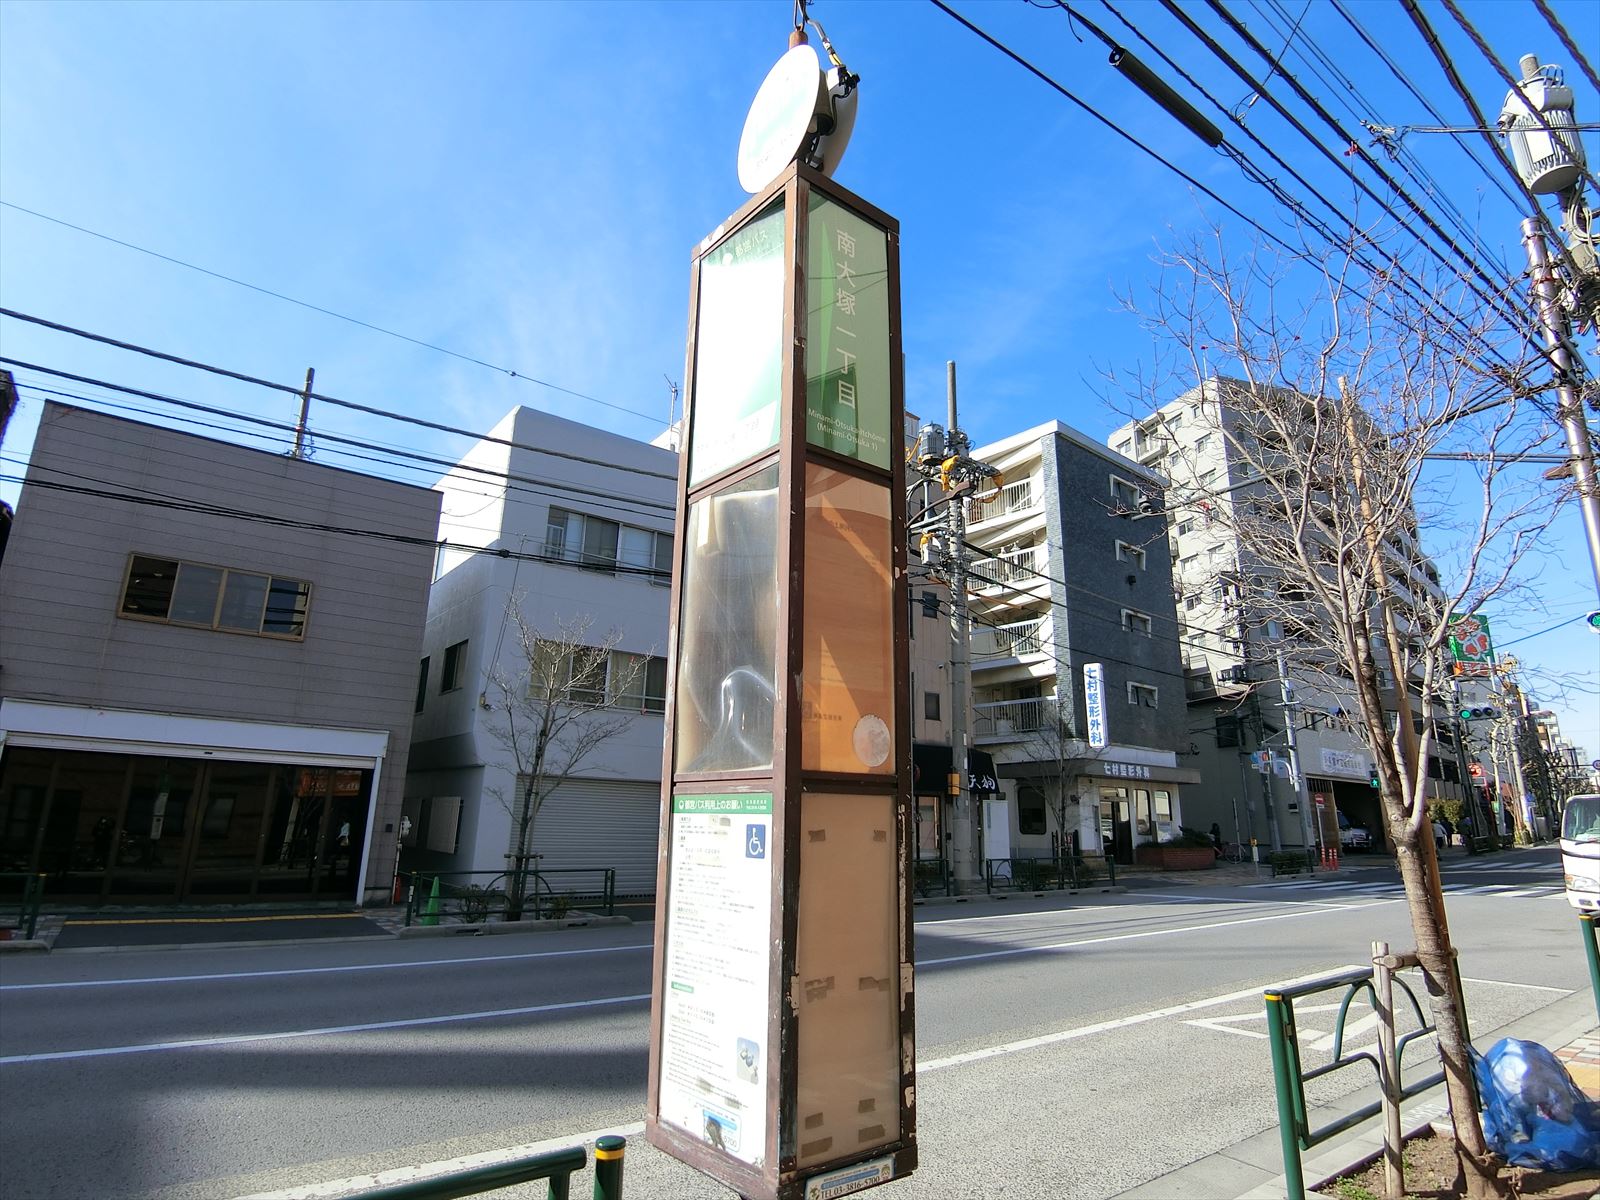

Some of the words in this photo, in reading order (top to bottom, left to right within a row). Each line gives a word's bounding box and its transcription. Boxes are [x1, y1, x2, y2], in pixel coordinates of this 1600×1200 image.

[735, 230, 768, 257] 都営バス
[836, 229, 857, 409] 南大塚一丁目
[1086, 667, 1103, 745] 七村整形外科
[1103, 762, 1150, 778] 七村整形外科
